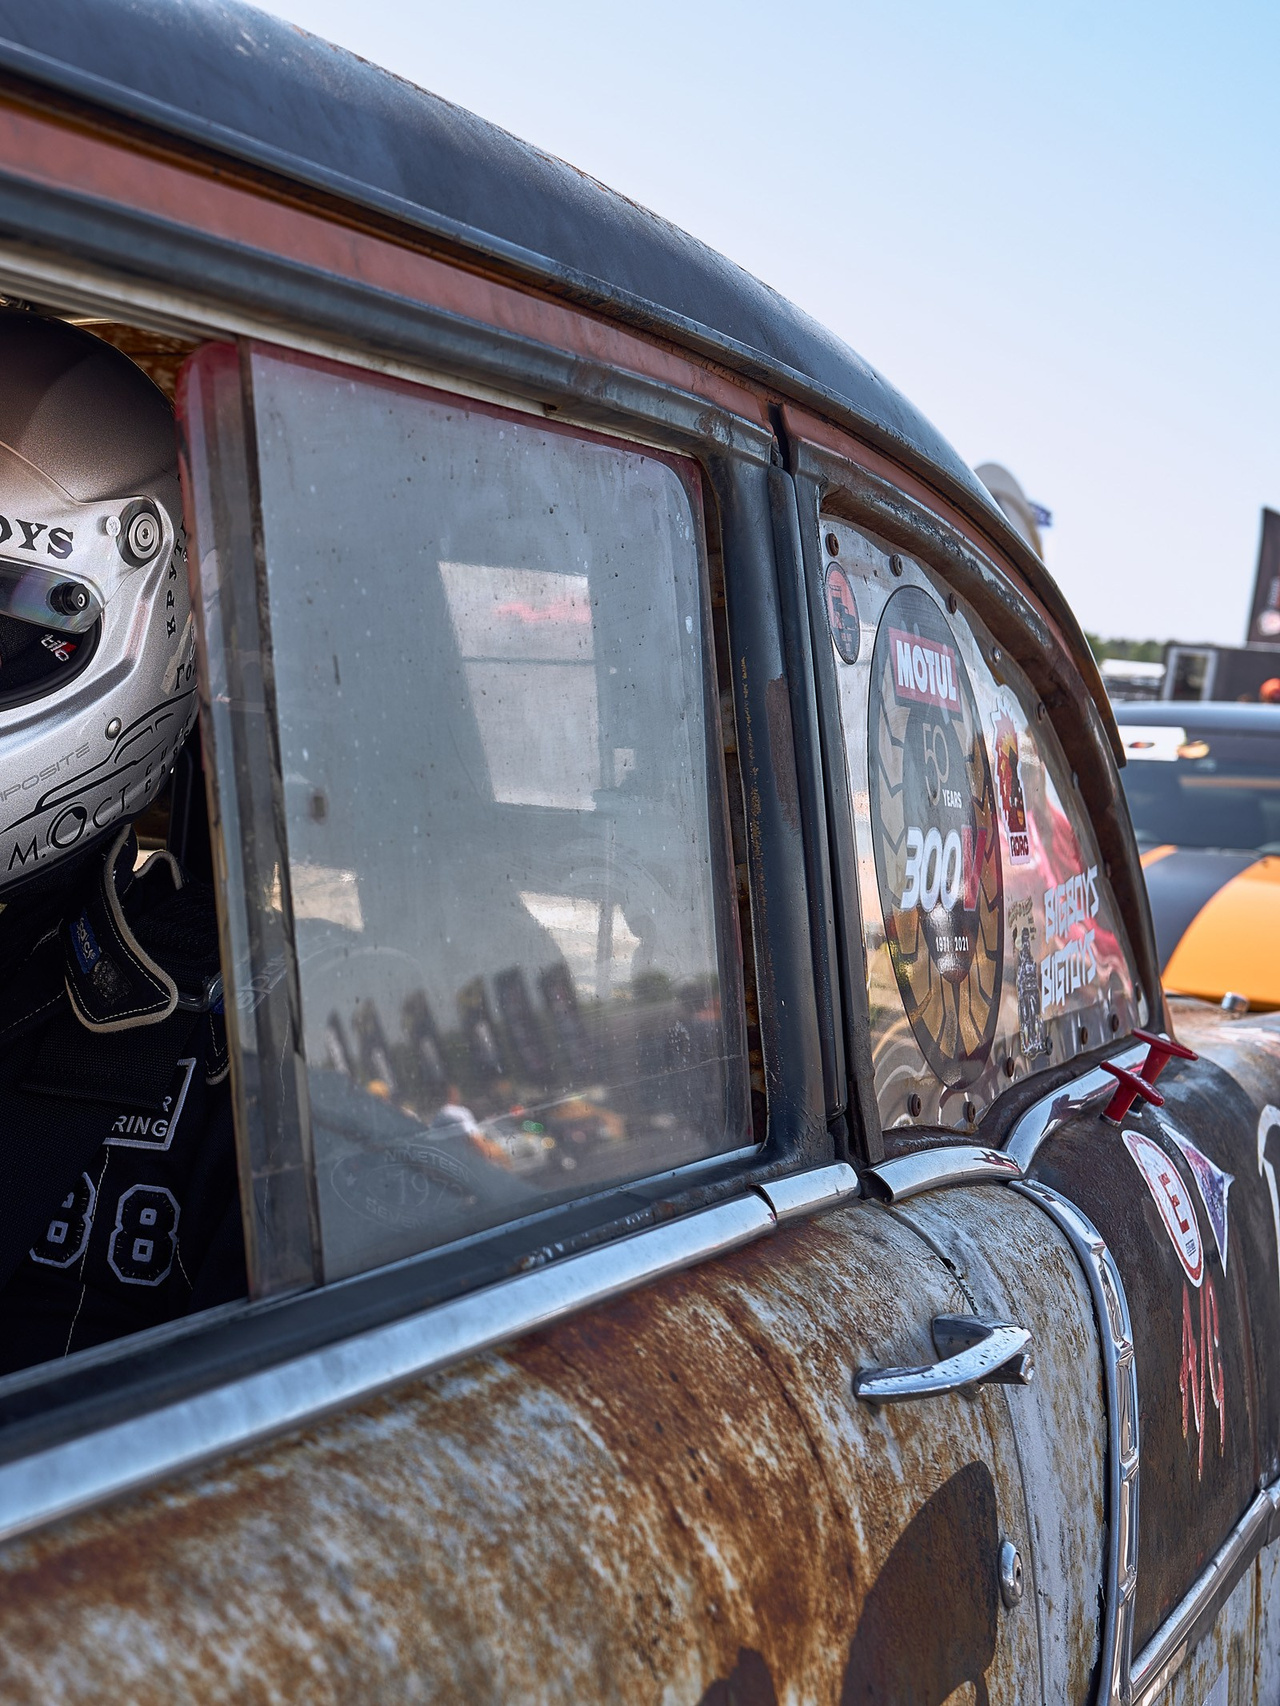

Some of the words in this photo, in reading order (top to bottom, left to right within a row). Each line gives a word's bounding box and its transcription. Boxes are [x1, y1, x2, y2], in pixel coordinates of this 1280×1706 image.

[895, 639, 957, 702] MOTUL
[922, 722, 949, 807] 50
[941, 788, 963, 810] YEARS
[900, 824, 988, 913] 300V
[954, 936, 969, 952] 2021
